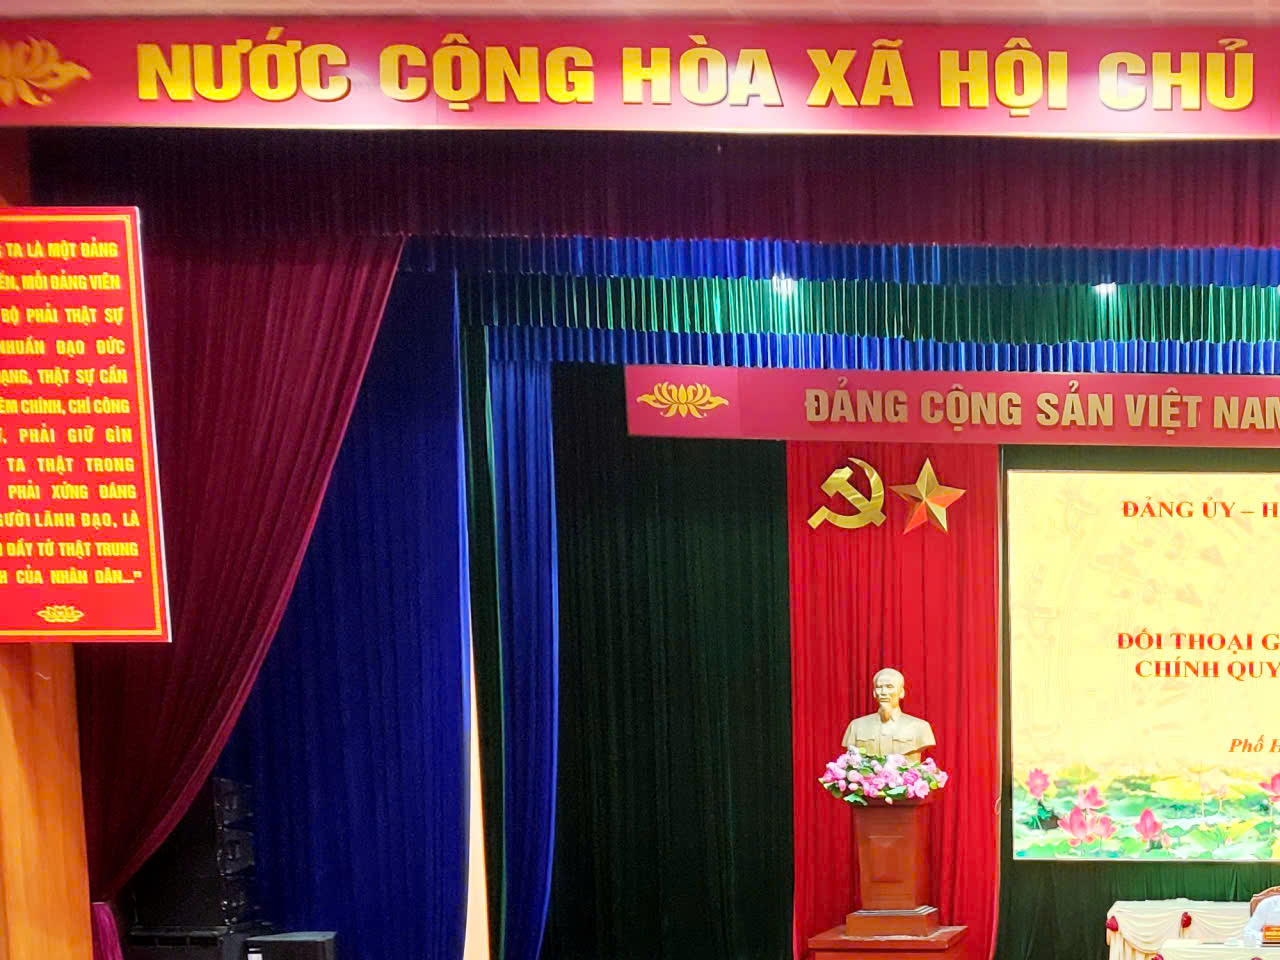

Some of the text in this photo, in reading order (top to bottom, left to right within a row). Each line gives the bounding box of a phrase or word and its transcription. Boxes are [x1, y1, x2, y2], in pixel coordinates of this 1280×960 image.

[136, 27, 351, 103] NƯỚC
[378, 32, 595, 111] CỘNG
[622, 35, 783, 107] HÒA
[807, 39, 914, 108] XÃ
[940, 38, 1070, 117] HỘI
[1098, 38, 1254, 112] CHỦ
[5, 242, 23, 257] TA
[27, 240, 43, 257] LÀ
[48, 240, 76, 260] MỘT
[81, 236, 118, 257] ĐẢNG
[89, 272, 120, 289] VIÊN
[27, 302, 58, 323] PHẢI
[64, 305, 97, 325] THẬT
[104, 306, 124, 325] SỰ
[0, 369, 32, 386] ẠNG,
[37, 366, 69, 386] THẬT
[75, 368, 95, 386] SỰ
[68, 396, 91, 414] CHÍ
[93, 396, 130, 414] CÔNG
[805, 381, 907, 425] ĐẢNG
[920, 384, 1022, 432] CỘNG
[1036, 381, 1113, 428] SẢN
[1125, 386, 1201, 435] VIỆT
[19, 423, 55, 443] PHẢI
[67, 425, 95, 443] GIỮ
[105, 425, 132, 443] GÌN
[6, 455, 135, 475] TA THẬT TRONG
[8, 480, 40, 499] PHẢI
[51, 481, 88, 499] XỨNG
[1121, 496, 1193, 518] ĐẢNG
[1202, 496, 1235, 518] ỦY
[34, 510, 75, 527] LÃNH
[122, 509, 140, 527] LÀ
[58, 540, 91, 560] THẬT
[94, 542, 139, 557] TRUNG
[16, 564, 43, 584] CỦA
[50, 567, 88, 584] NHÂN
[1116, 628, 1163, 650] ĐỐI
[1170, 633, 1253, 655] THOẠI
[1135, 656, 1220, 678] CHÍNH
[1228, 735, 1264, 753] Phố
